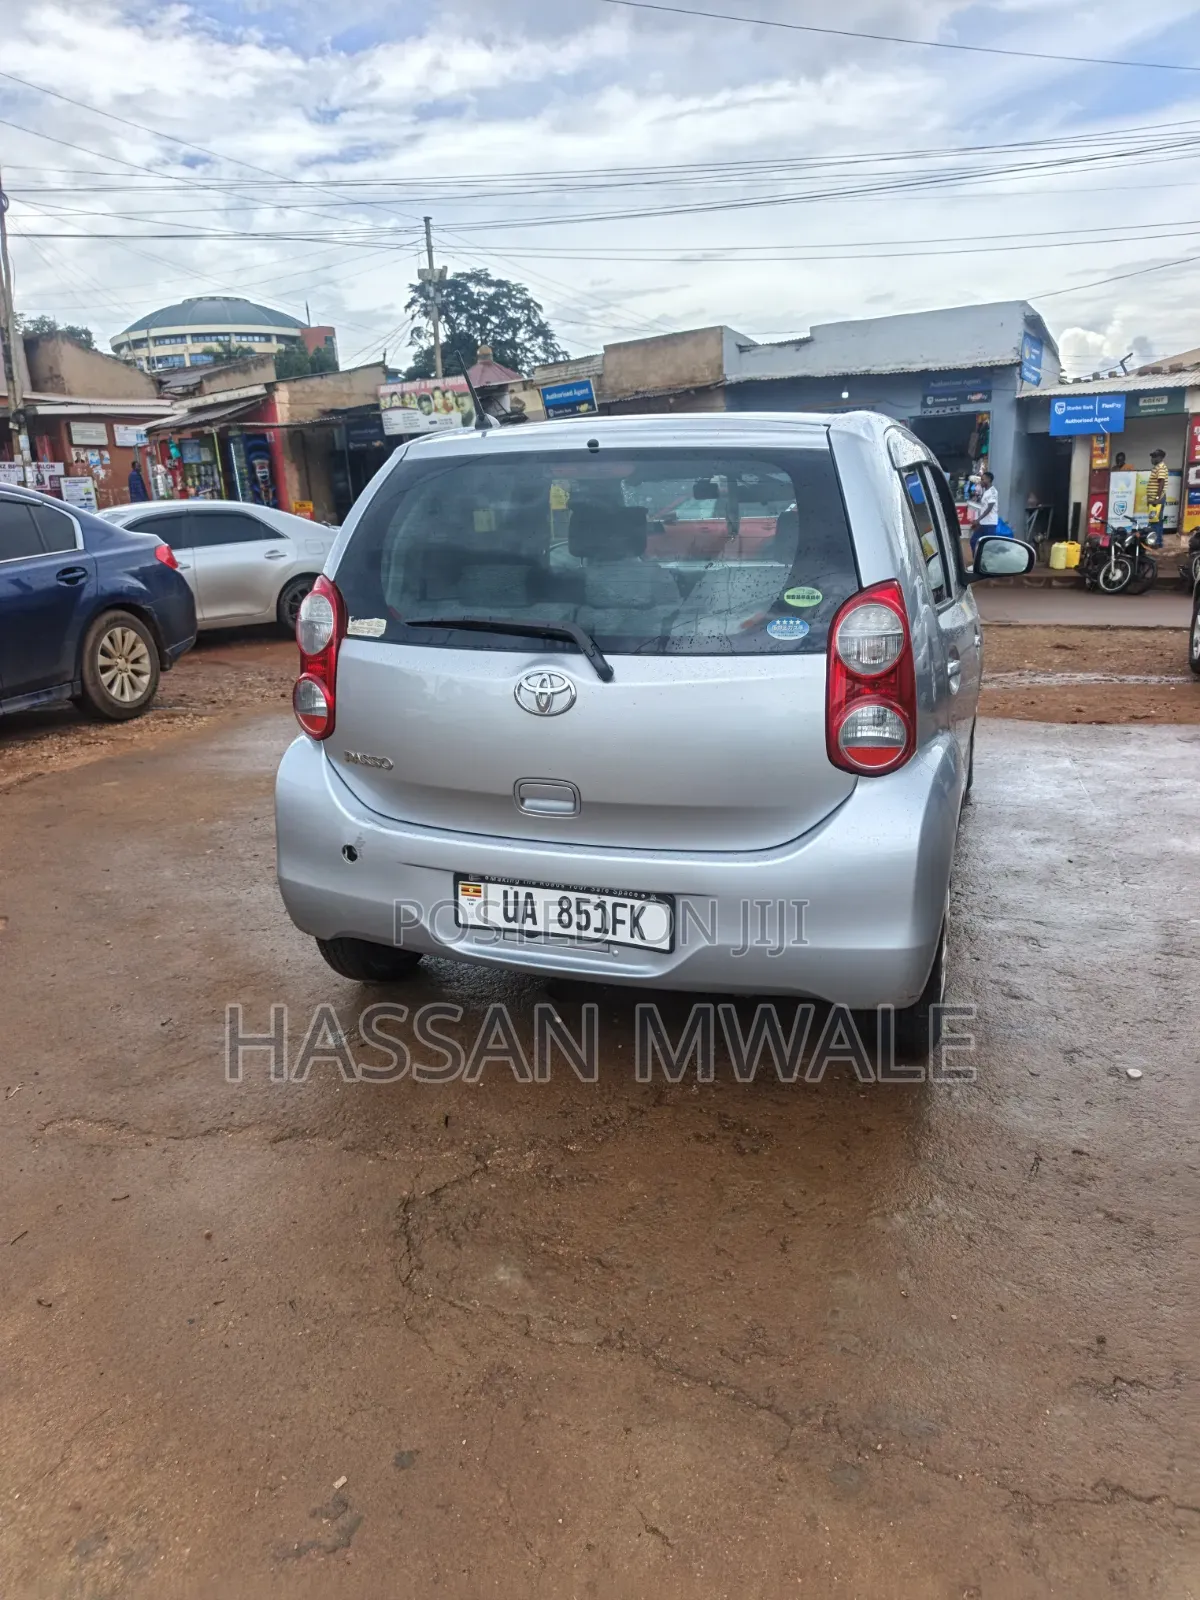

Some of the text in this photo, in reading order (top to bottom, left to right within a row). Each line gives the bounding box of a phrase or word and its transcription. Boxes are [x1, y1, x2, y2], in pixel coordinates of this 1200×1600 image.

[1094, 416, 1110, 424] Agent
[613, 890, 639, 898] Space
[503, 889, 538, 926] UA
